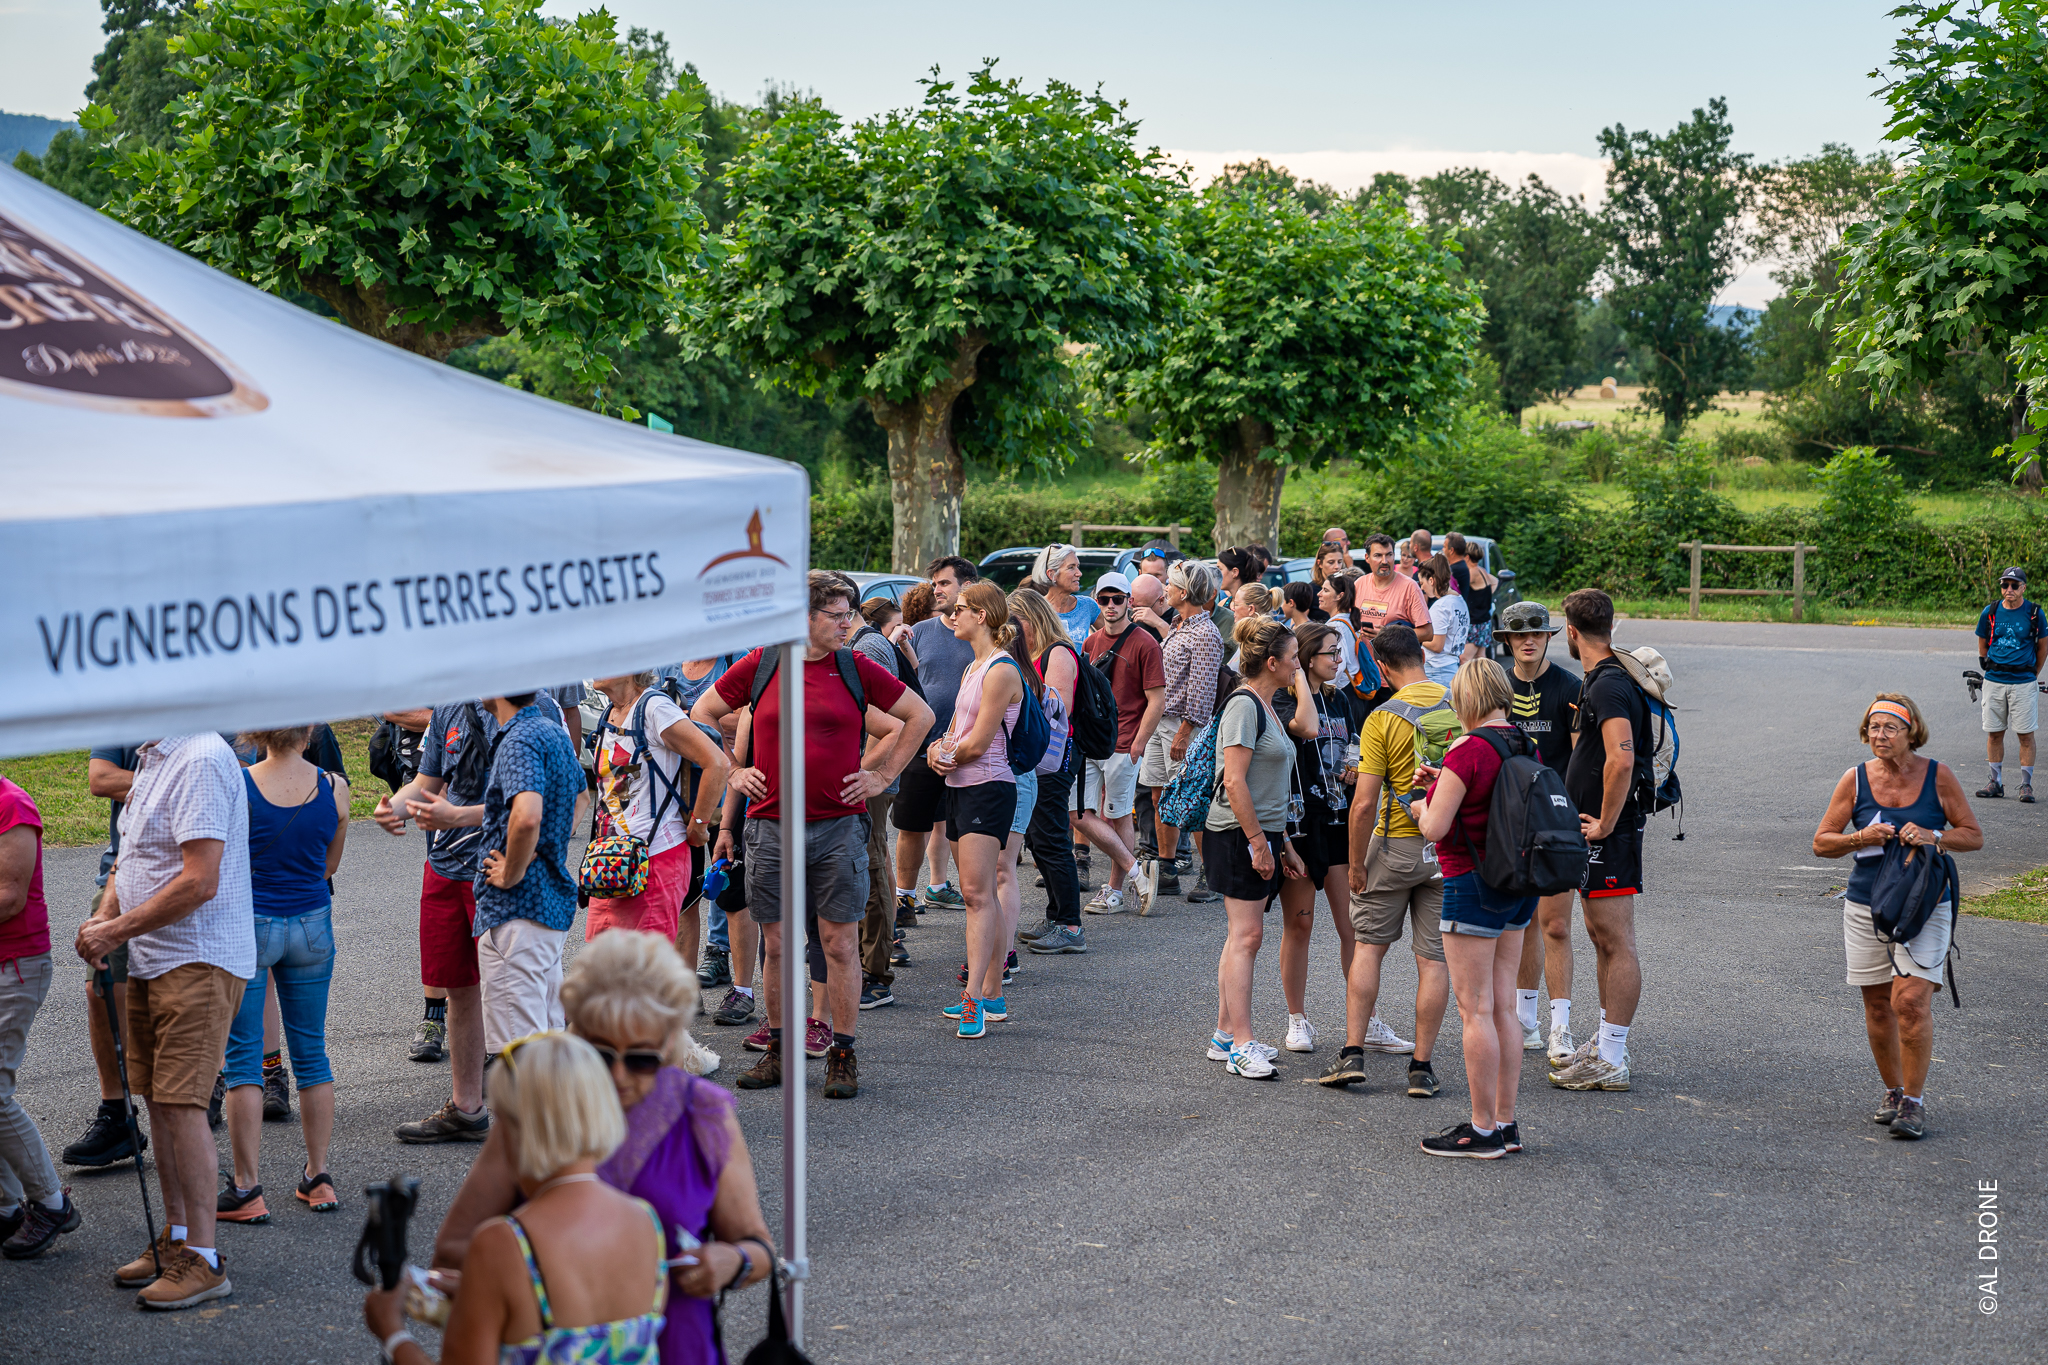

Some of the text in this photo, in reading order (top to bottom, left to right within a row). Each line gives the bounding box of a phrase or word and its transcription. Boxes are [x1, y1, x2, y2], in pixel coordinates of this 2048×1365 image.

[37, 550, 665, 676] VIGNERONS DES TERRES SECRETES
